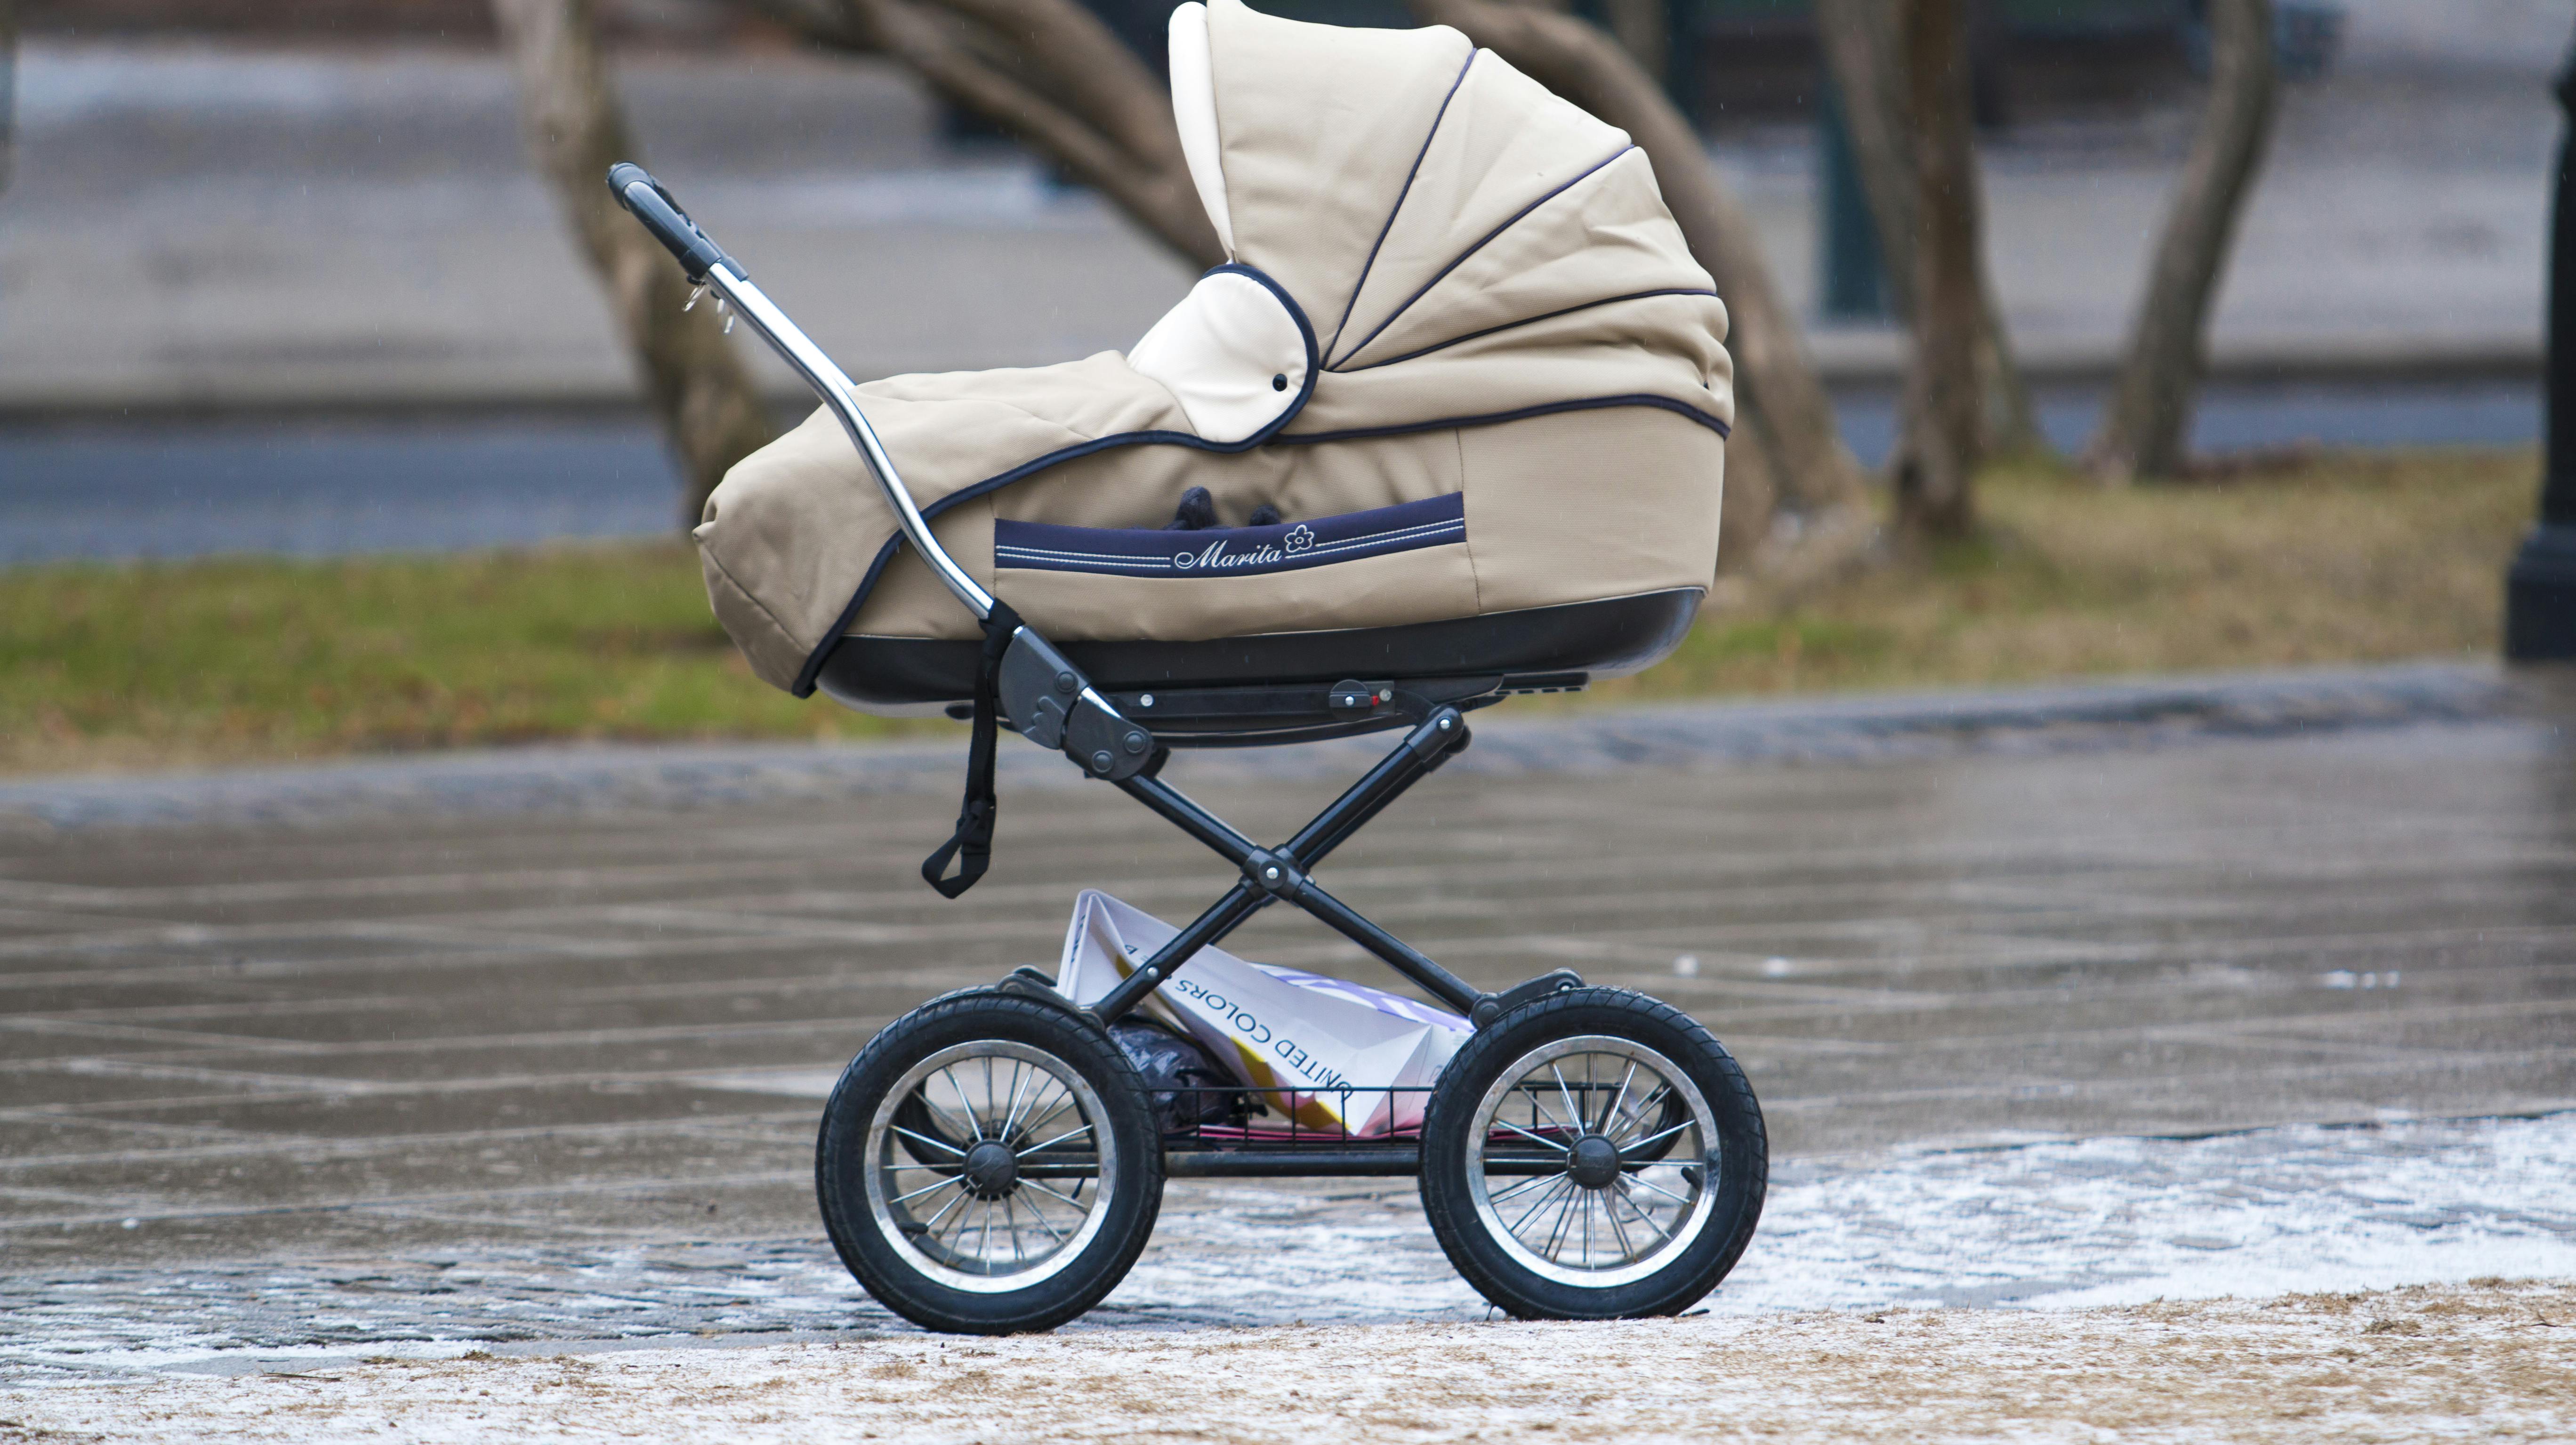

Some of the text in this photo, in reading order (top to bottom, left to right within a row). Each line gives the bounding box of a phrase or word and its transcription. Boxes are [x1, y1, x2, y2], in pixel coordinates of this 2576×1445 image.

[1175, 540, 1282, 569] Marita
[1175, 980, 1353, 1102] UNITED COLORS
